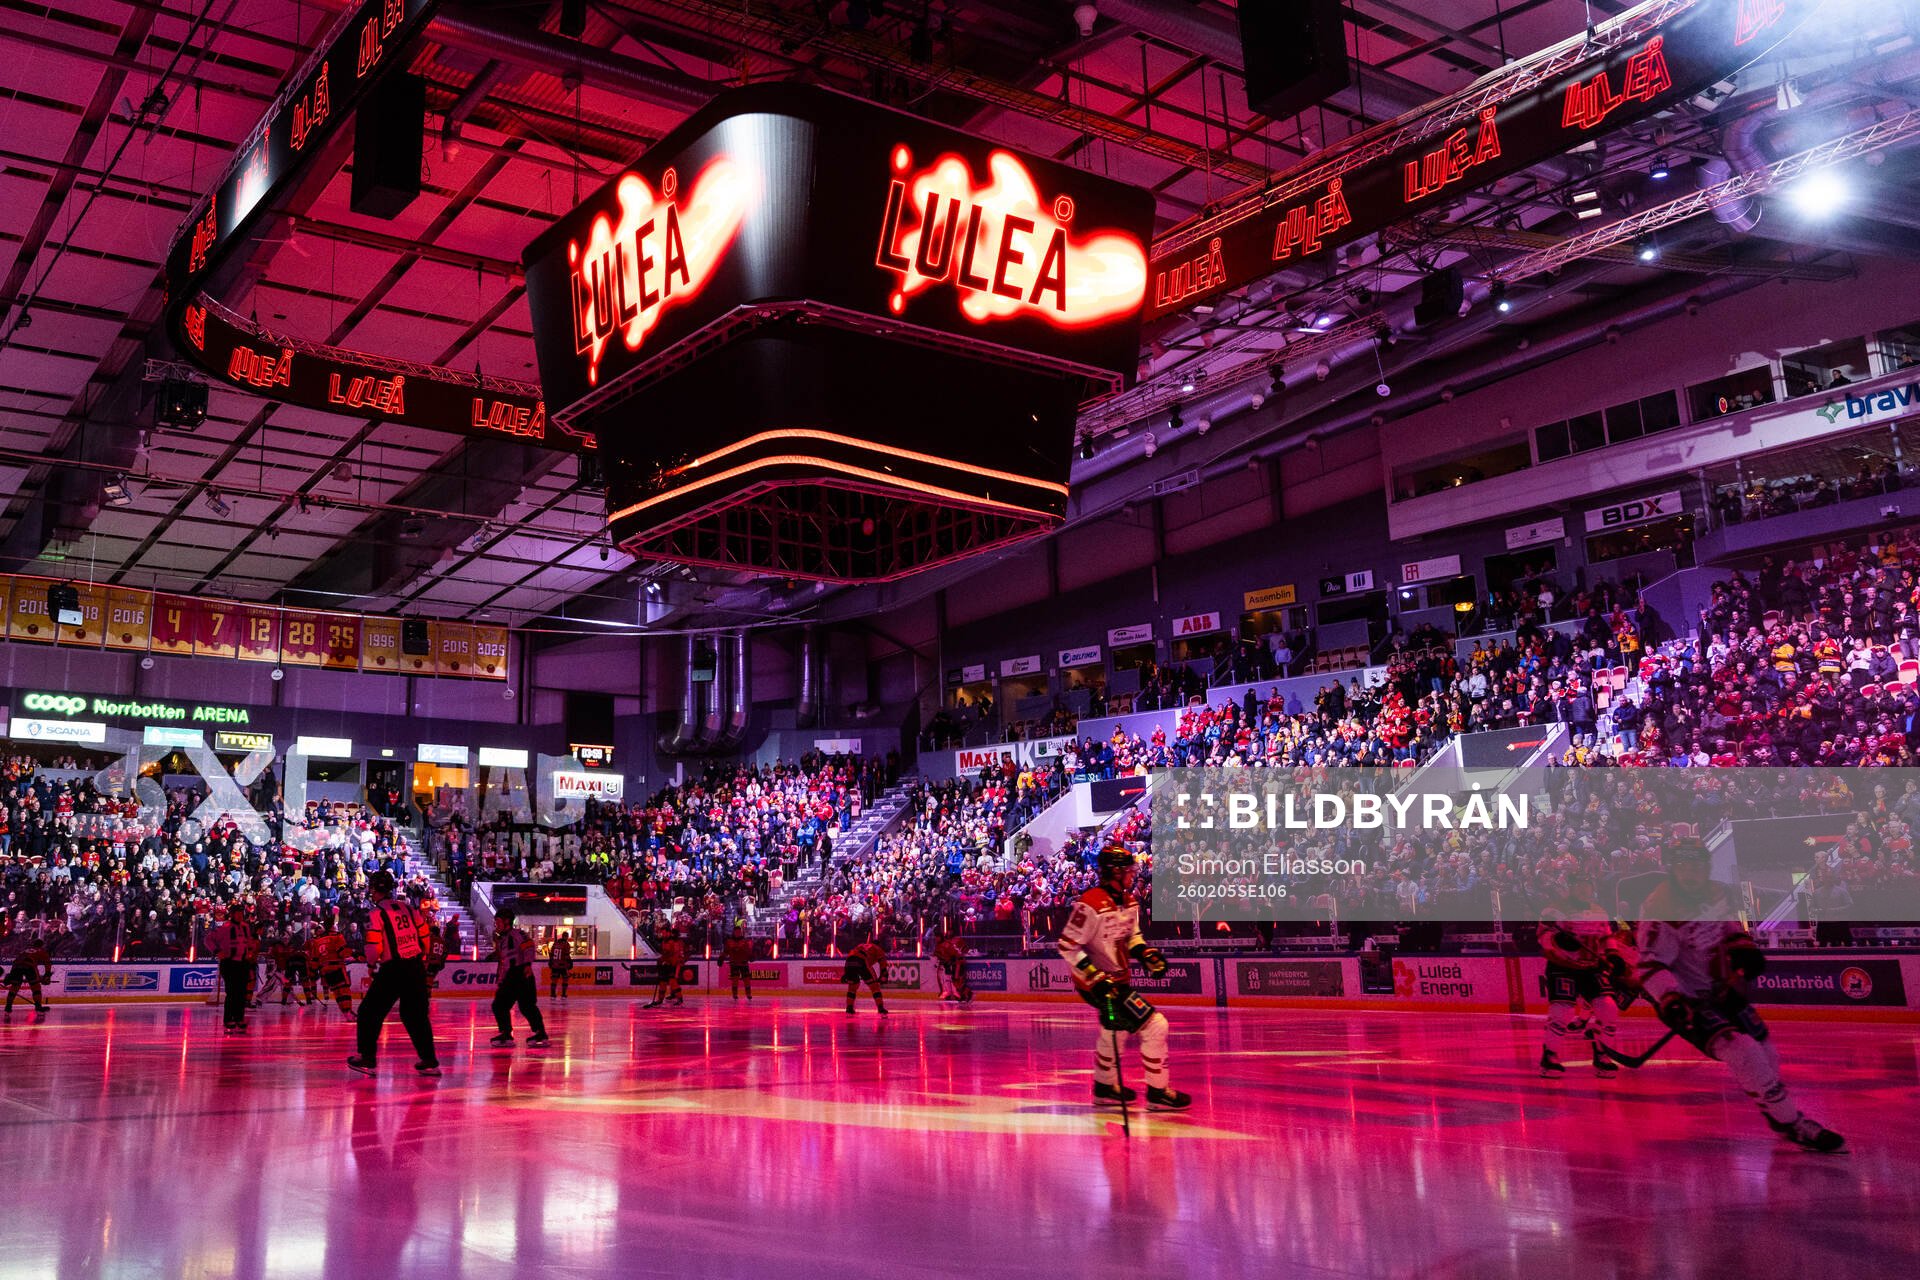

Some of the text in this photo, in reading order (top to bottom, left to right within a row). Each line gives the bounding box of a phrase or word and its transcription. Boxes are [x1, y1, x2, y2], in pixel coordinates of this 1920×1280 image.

[876, 180, 1074, 312] LULEÅ
[571, 167, 690, 355] LULEÅ
[1155, 237, 1227, 309] LULEÅ
[328, 373, 405, 415] LULEÅ
[1845, 383, 1920, 419] brav
[472, 398, 545, 439] LULEÅ
[1602, 497, 1664, 525] BDX
[1249, 590, 1291, 604] Assemblin
[113, 608, 144, 625] 2016
[168, 609, 181, 633] 4
[212, 613, 224, 637] 7
[1181, 615, 1212, 633] ABB
[250, 617, 271, 642] 12
[289, 621, 315, 646] 28
[23, 693, 250, 724] coop Norrbotten ARENA
[46, 726, 91, 737] SCANIA
[220, 733, 269, 747] TITAN
[560, 776, 602, 791] MAXI
[669, 762, 684, 787] J
[394, 915, 410, 931] 29
[553, 949, 563, 960] 91
[596, 971, 613, 982] CAT
[888, 966, 919, 985] oop
[1051, 974, 1073, 983] ALLBY
[1419, 962, 1462, 979] Luleå
[1420, 982, 1474, 997] Energi
[1756, 973, 1835, 990] Polarbröd
